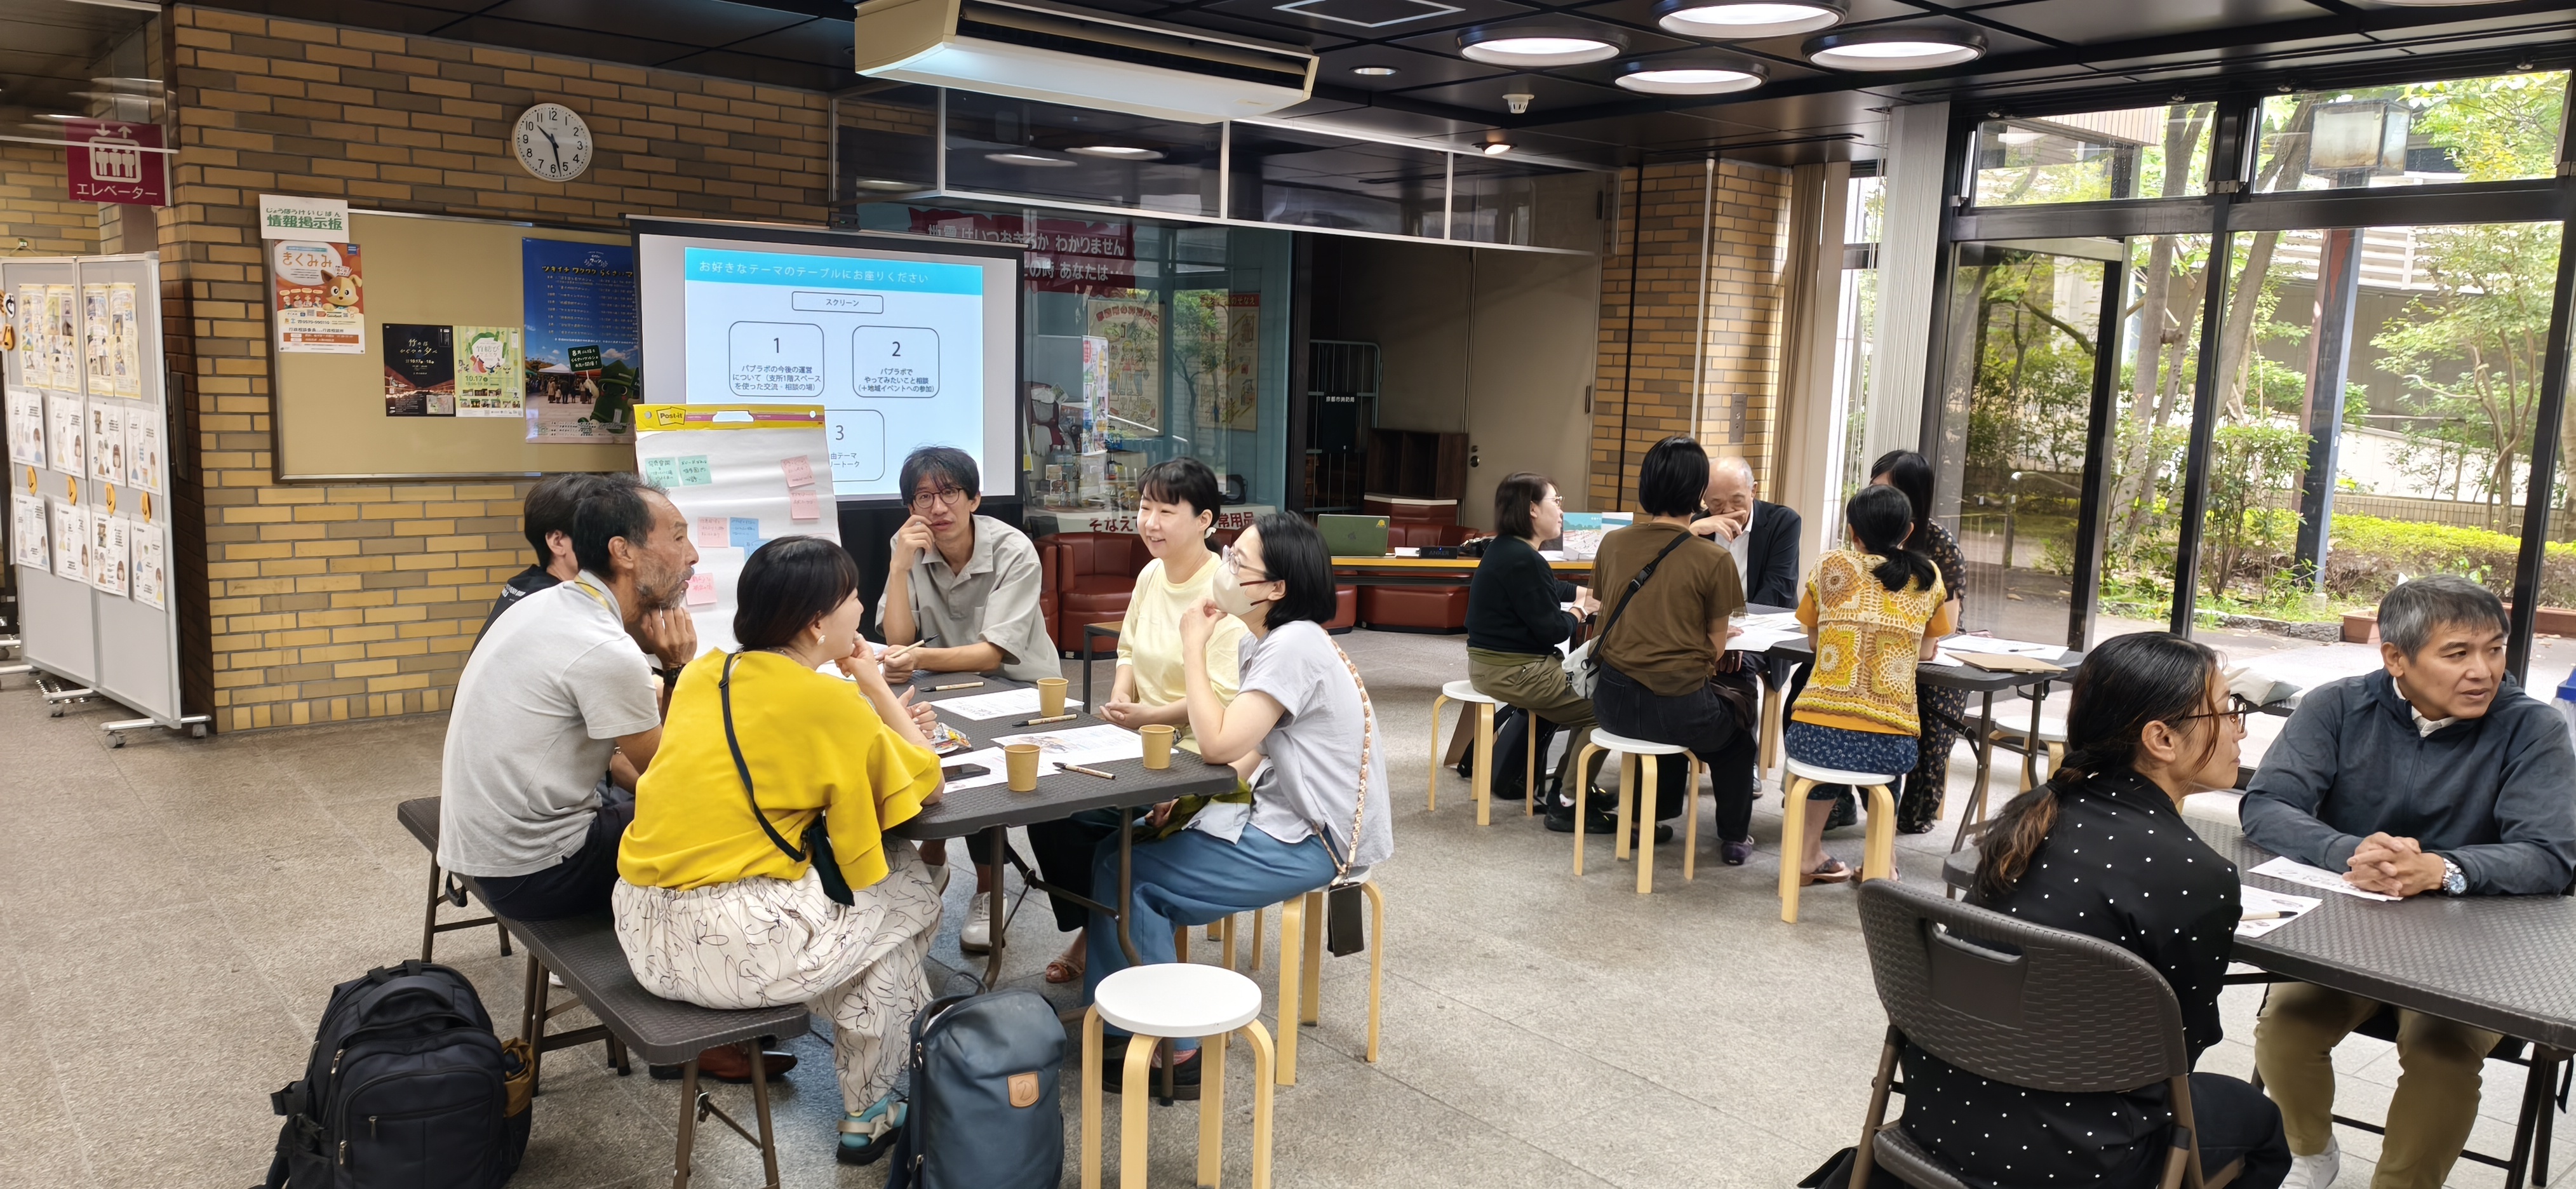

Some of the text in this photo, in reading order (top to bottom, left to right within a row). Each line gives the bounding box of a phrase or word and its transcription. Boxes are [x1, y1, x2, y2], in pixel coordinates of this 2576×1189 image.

[537, 112, 543, 123] 11
[549, 110, 558, 121] 12
[526, 121, 533, 131] 10
[573, 127, 579, 137] 2
[523, 134, 528, 144] 9
[577, 140, 583, 150] 3
[527, 148, 532, 158] 8
[572, 154, 580, 163] 4
[538, 159, 544, 169] 7
[550, 164, 556, 173] 6
[562, 161, 568, 171] 5
[76, 183, 158, 199] エレベーター
[267, 214, 343, 230] 情報掲示板
[1055, 234, 1125, 257] わかりません
[283, 252, 332, 267] きくみみ
[699, 260, 929, 284] お好きなテーマのテーブルにお座りください
[826, 298, 860, 307] スクリーン
[774, 337, 780, 353] 1
[892, 341, 901, 357] 2
[741, 365, 813, 374] パブラボの今後の運営
[880, 368, 913, 376] パブラボで
[864, 376, 929, 385] やってみたいこと相談
[835, 425, 844, 441] 3
